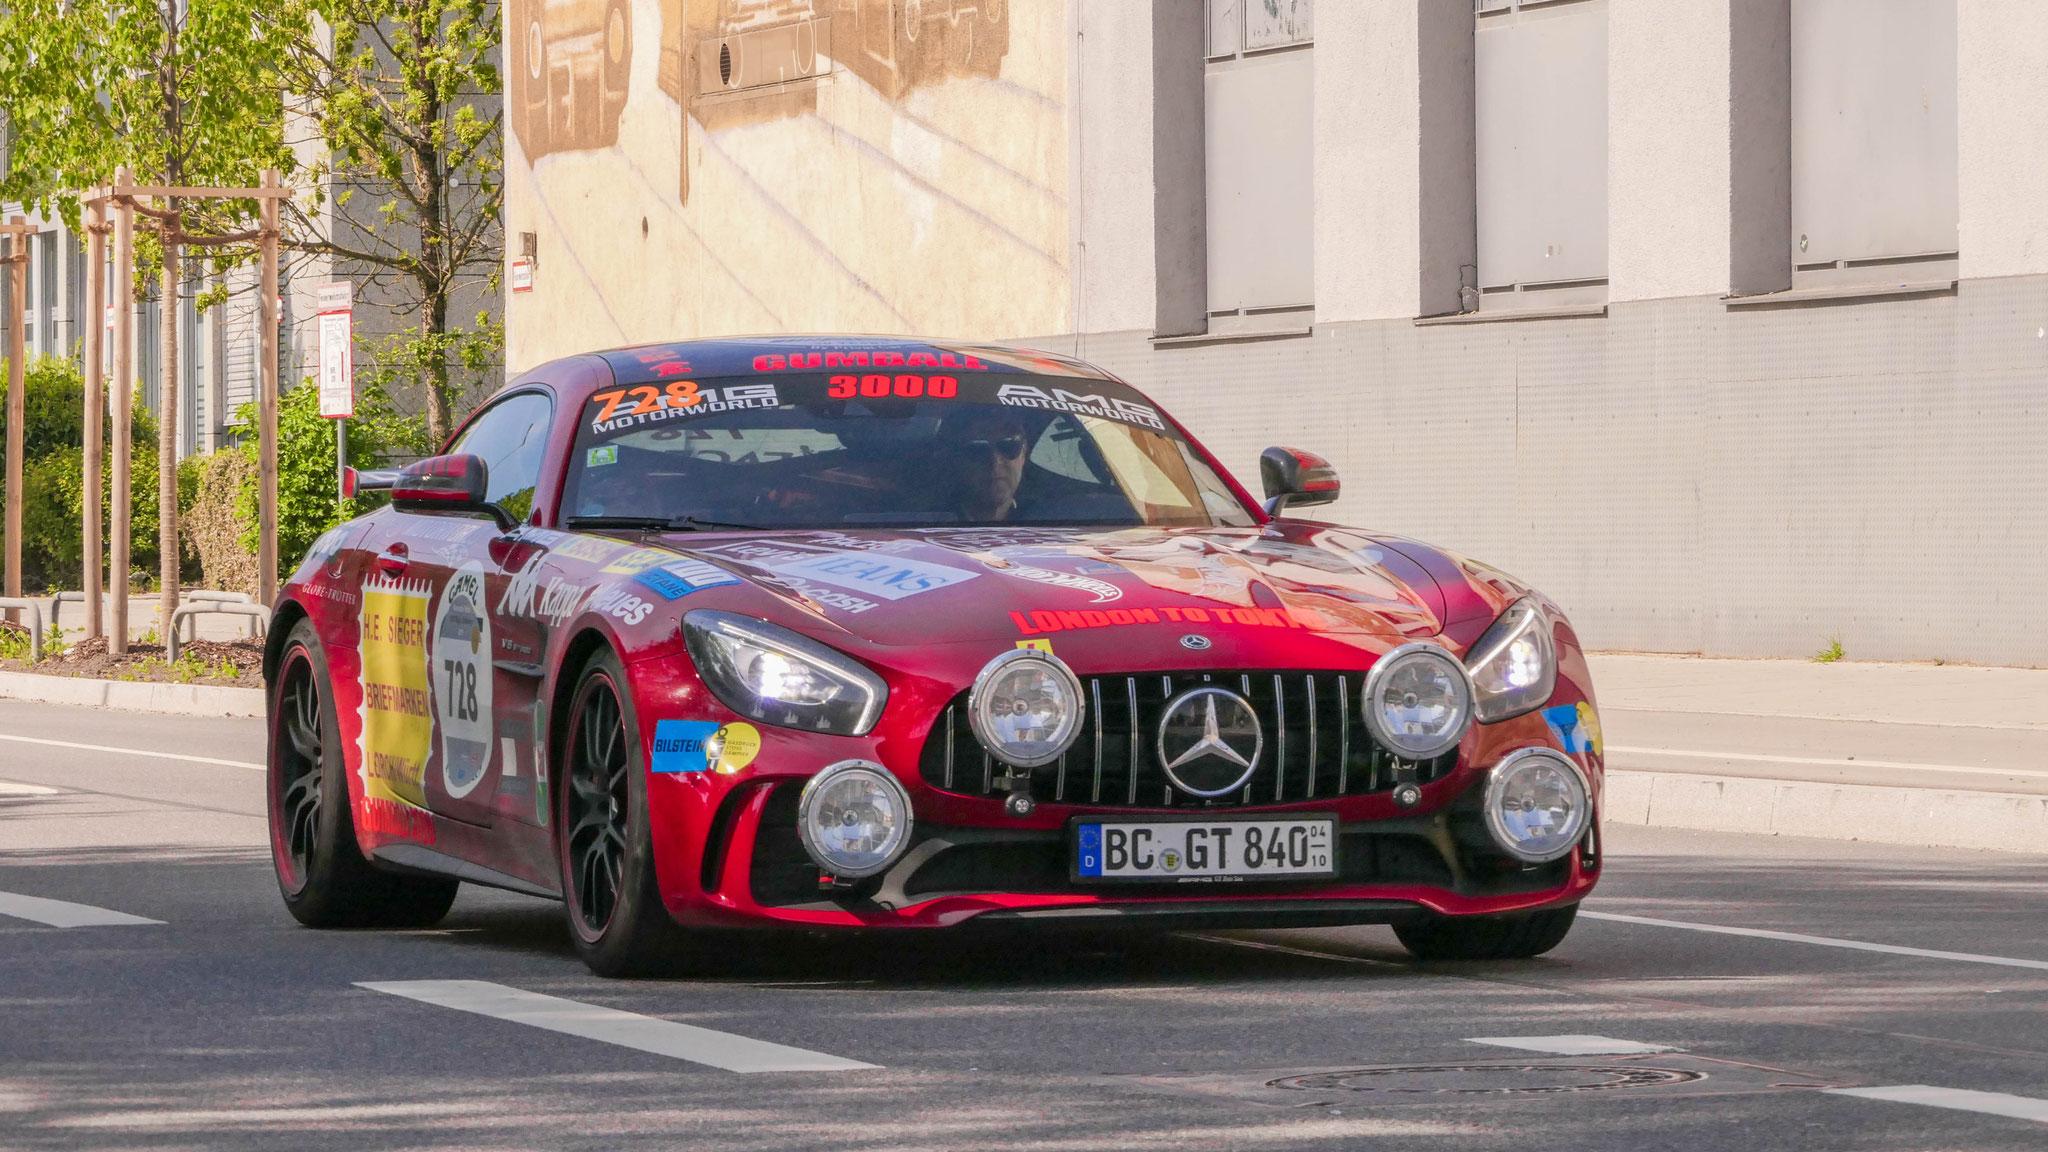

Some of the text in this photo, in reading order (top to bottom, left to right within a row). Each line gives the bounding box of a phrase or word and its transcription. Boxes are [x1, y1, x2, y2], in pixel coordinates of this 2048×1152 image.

[753, 351, 988, 371] GUMBALL
[593, 381, 701, 422] 728
[828, 374, 958, 399] 3000
[997, 384, 1160, 422] AMG
[593, 397, 779, 434] MOTORWORLD
[999, 396, 1166, 430] MOTORWORLD
[801, 556, 949, 590] JEANS
[302, 582, 357, 605] GLOBE-TROTTER
[448, 575, 478, 606] CAMEL
[538, 576, 586, 627] Kappa
[363, 613, 424, 646] H.E. SIEGER
[1009, 608, 1160, 635] LONDON
[1159, 606, 1210, 623] TO
[366, 683, 430, 717] BRIEFMARKEN
[445, 659, 479, 722] 728
[655, 739, 706, 752] BILSTEIN
[1105, 826, 1308, 870] BC GT 840
[1310, 825, 1327, 838] 04
[1085, 856, 1095, 868] D
[1310, 854, 1327, 867] 10
